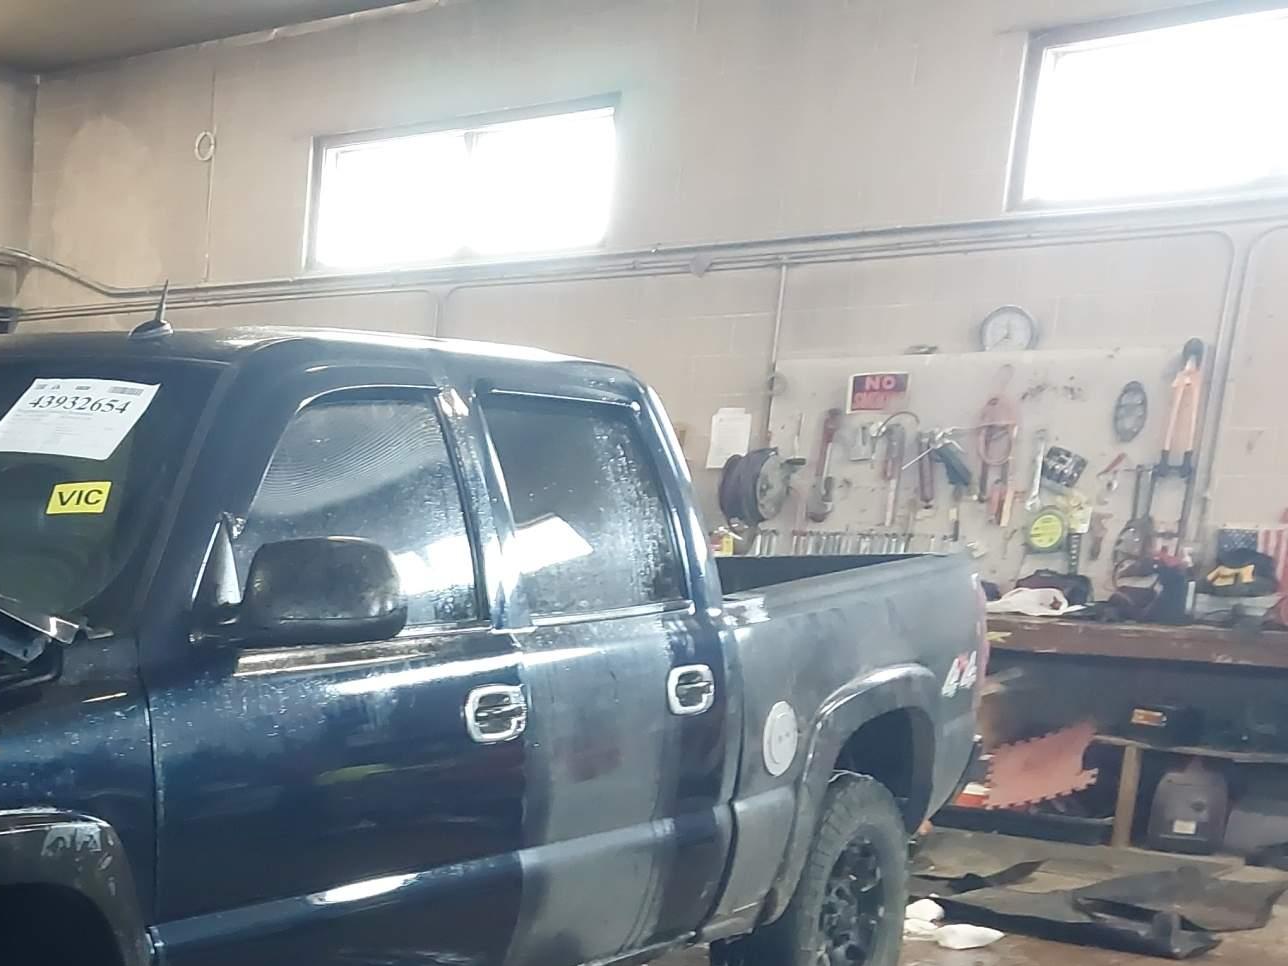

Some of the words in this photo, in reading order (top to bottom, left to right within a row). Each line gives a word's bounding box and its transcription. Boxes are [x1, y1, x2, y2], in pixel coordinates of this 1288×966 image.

[865, 376, 896, 391] NO
[29, 395, 131, 413] 43932654
[57, 489, 103, 506] VIC
